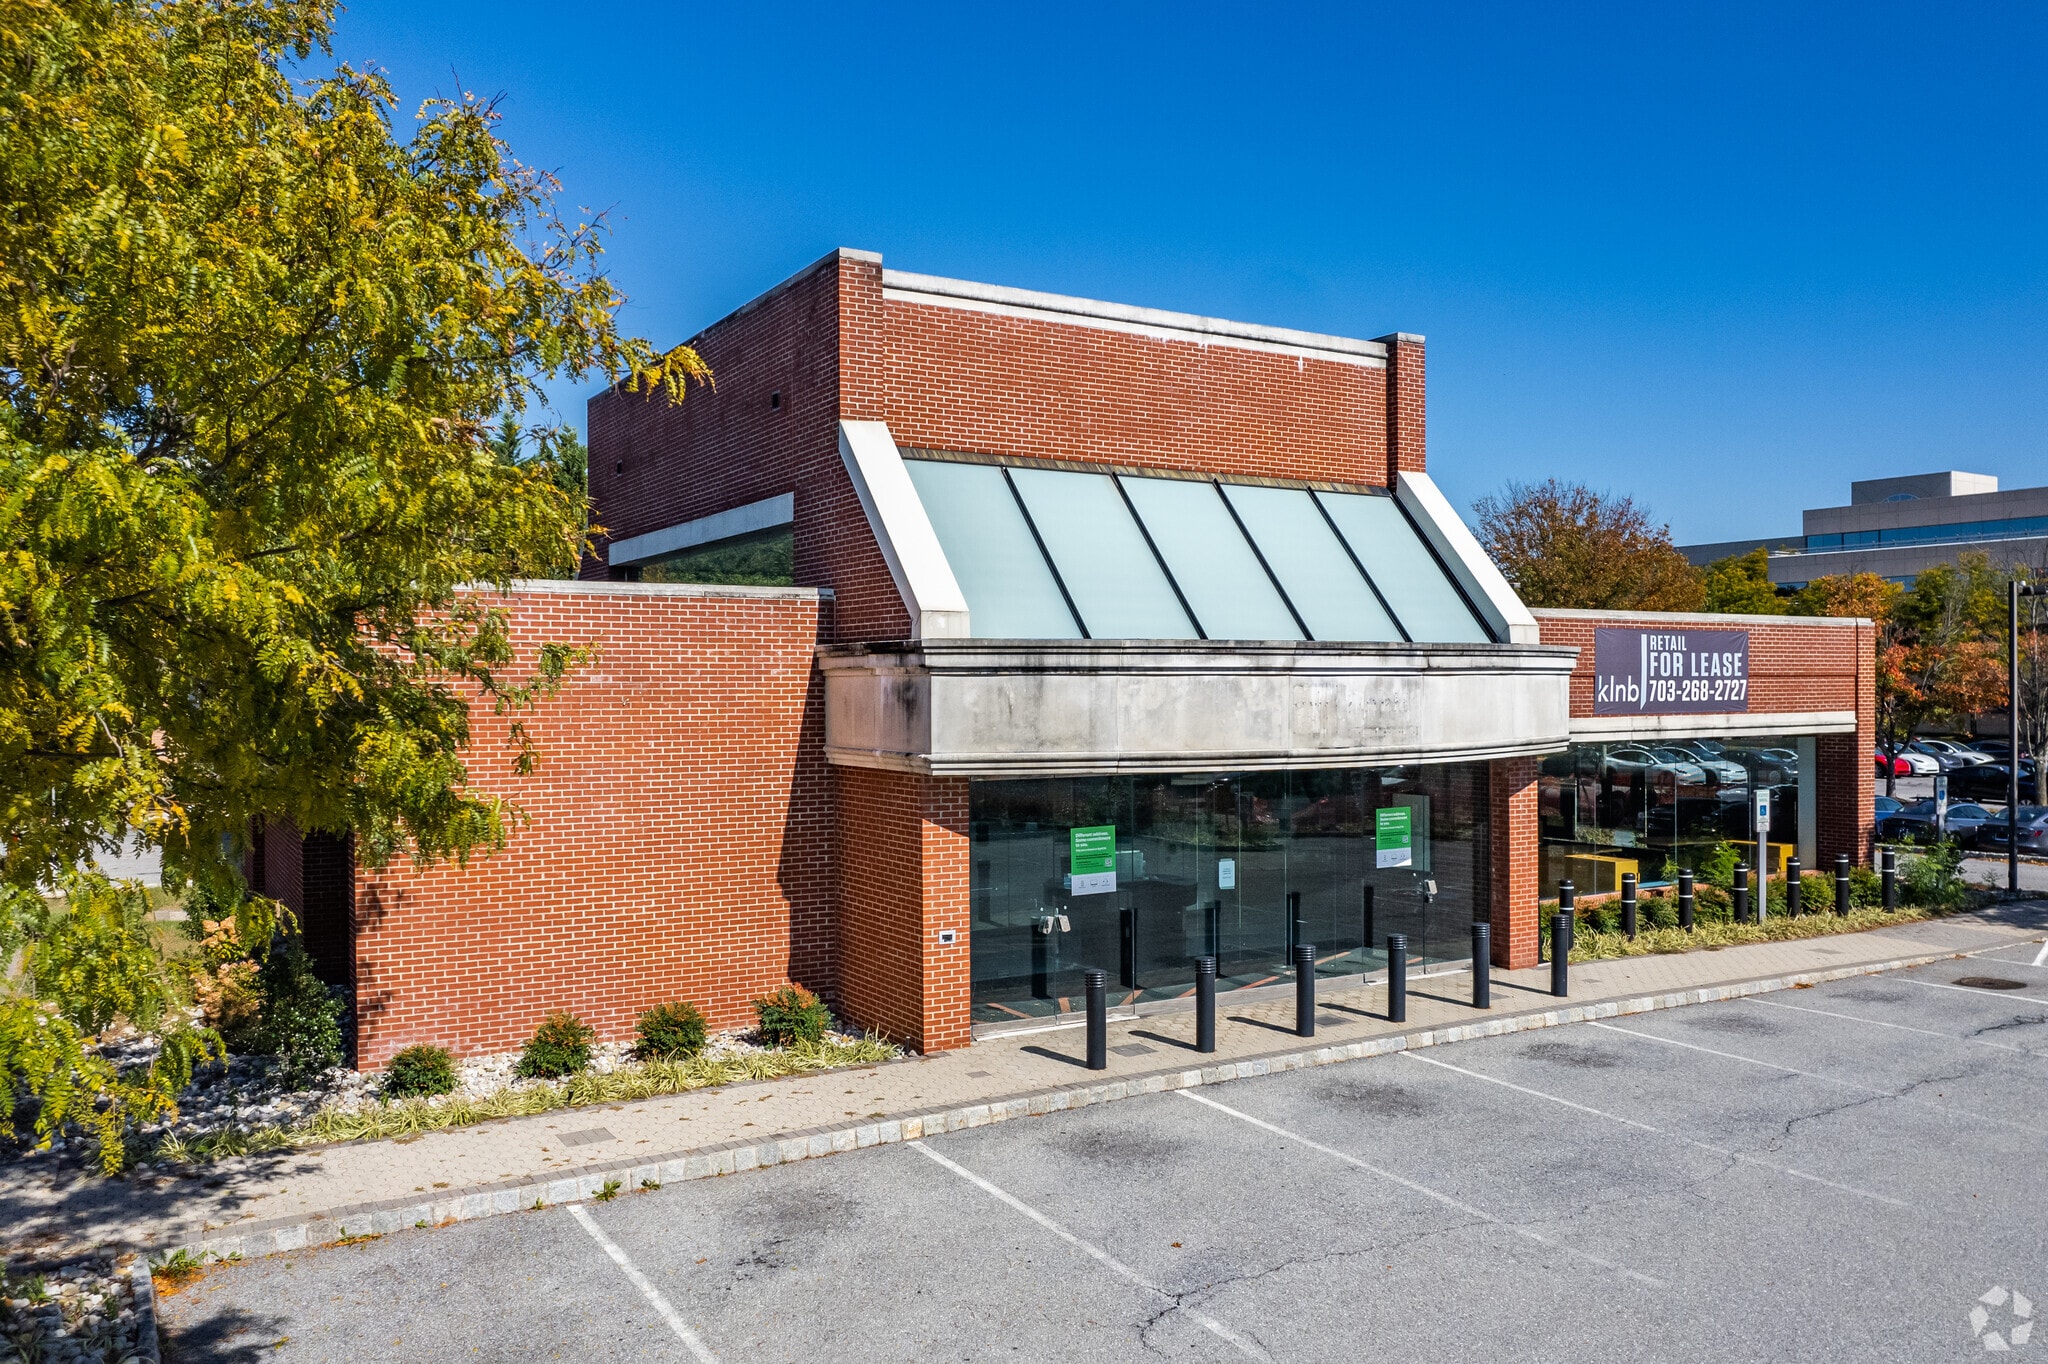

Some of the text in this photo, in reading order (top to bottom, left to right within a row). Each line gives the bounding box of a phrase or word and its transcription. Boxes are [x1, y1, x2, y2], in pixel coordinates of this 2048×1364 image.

[1649, 635, 1687, 651] RETAIL
[1649, 652, 1743, 677] FOR LEASE
[1597, 675, 1640, 703] klnb
[1649, 679, 1748, 702] 703-268-2727
